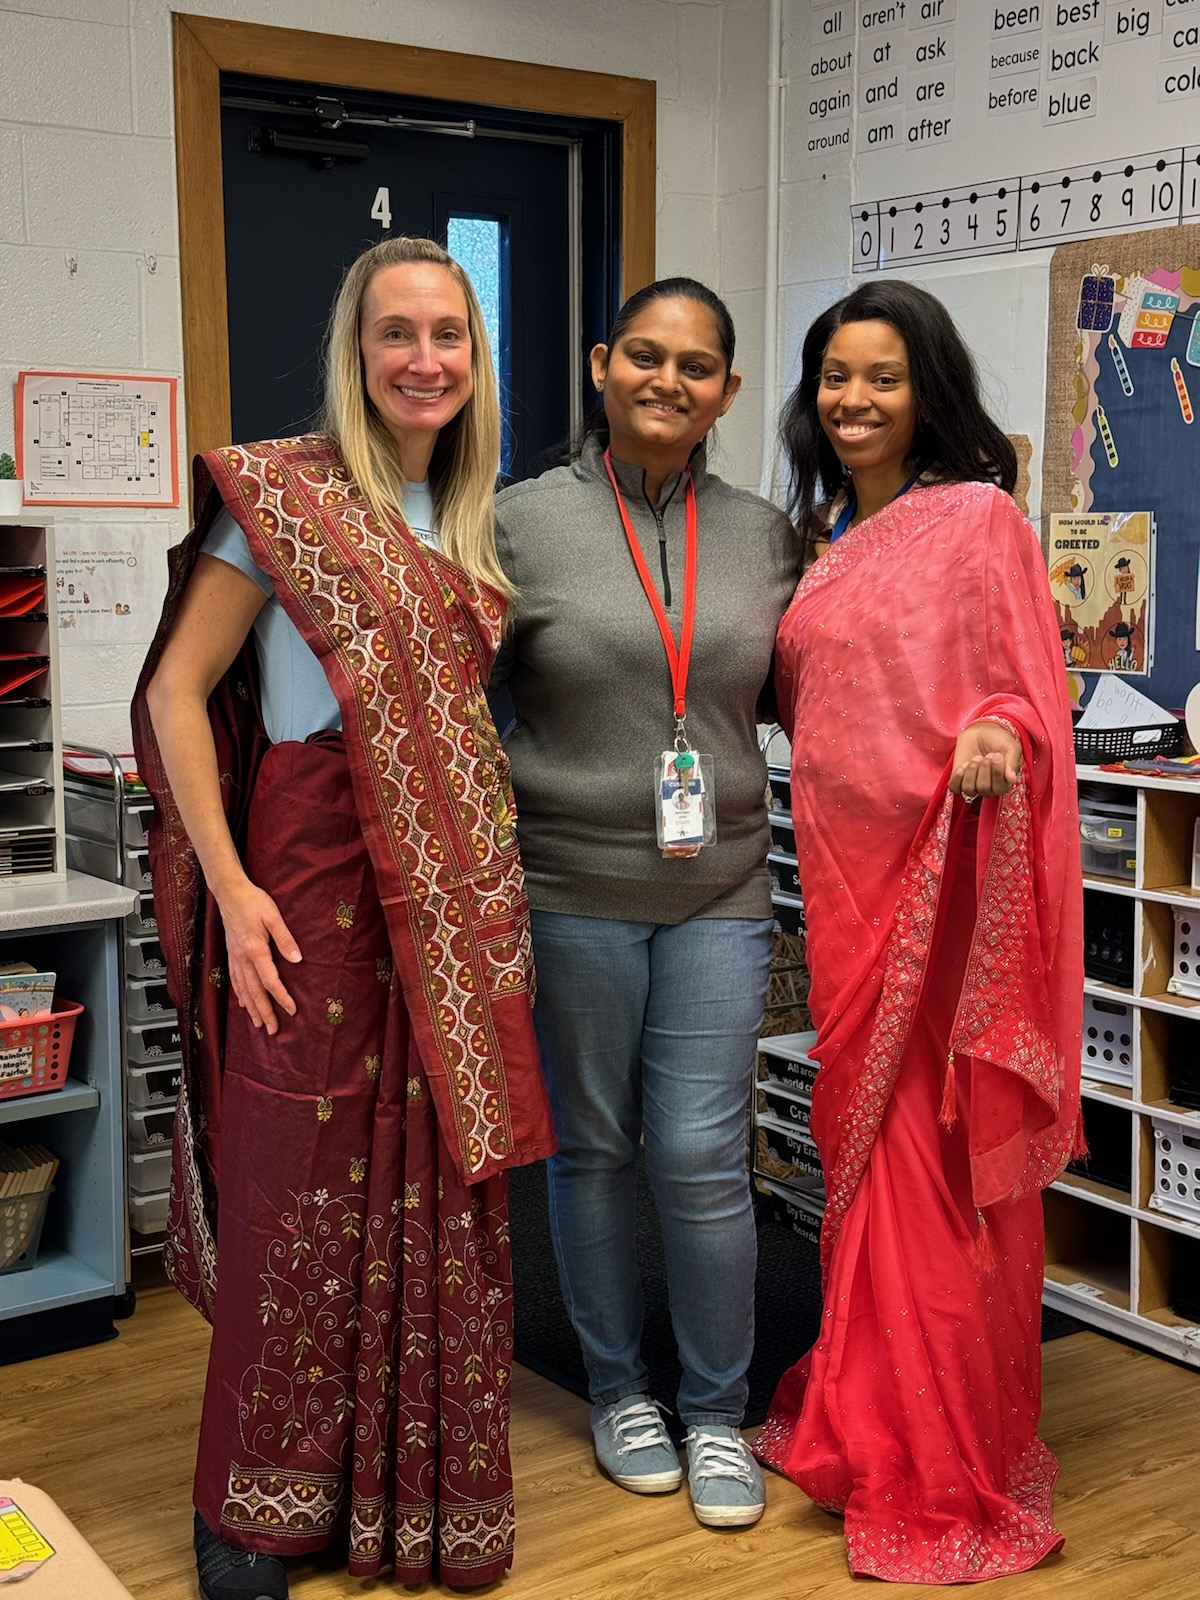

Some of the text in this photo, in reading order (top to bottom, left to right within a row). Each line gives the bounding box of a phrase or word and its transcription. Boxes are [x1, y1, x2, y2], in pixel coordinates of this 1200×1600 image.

[862, 1, 906, 28] aren't
[921, 0, 944, 19] air
[994, 5, 1040, 30] been
[1056, 0, 1100, 26] best
[823, 11, 842, 34] all
[1117, 8, 1150, 36] big
[1173, 27, 1198, 48] ca
[873, 42, 891, 63] at
[916, 37, 946, 62] ask
[991, 48, 1039, 69] because
[1051, 41, 1100, 71] back
[810, 51, 852, 76] about
[865, 76, 898, 103] and
[916, 81, 945, 101] are
[988, 87, 1037, 109] before
[809, 90, 850, 117] again
[1048, 92, 1091, 117] blue
[807, 128, 849, 151] around
[868, 124, 894, 143] am
[908, 118, 951, 142] after
[371, 187, 392, 228] 4
[860, 231, 872, 256] 0
[890, 227, 895, 253] 1
[914, 223, 923, 249] 2
[940, 218, 950, 245] 3
[968, 213, 978, 240] 4
[996, 209, 1007, 237] 5
[1030, 204, 1040, 232] 6
[1061, 198, 1071, 227] 7
[1090, 193, 1102, 222] 8
[1122, 187, 1133, 216] 9
[1151, 182, 1174, 213] 10
[1054, 539, 1100, 550] GREETED
[1118, 581, 1132, 590] HUG
[1108, 656, 1138, 671] HELLO
[3, 1060, 27, 1069] Magic
[787, 1062, 818, 1079] All arou
[782, 1076, 804, 1090] world
[786, 1136, 801, 1154] Dry
[786, 1202, 819, 1228] Dry Erase
